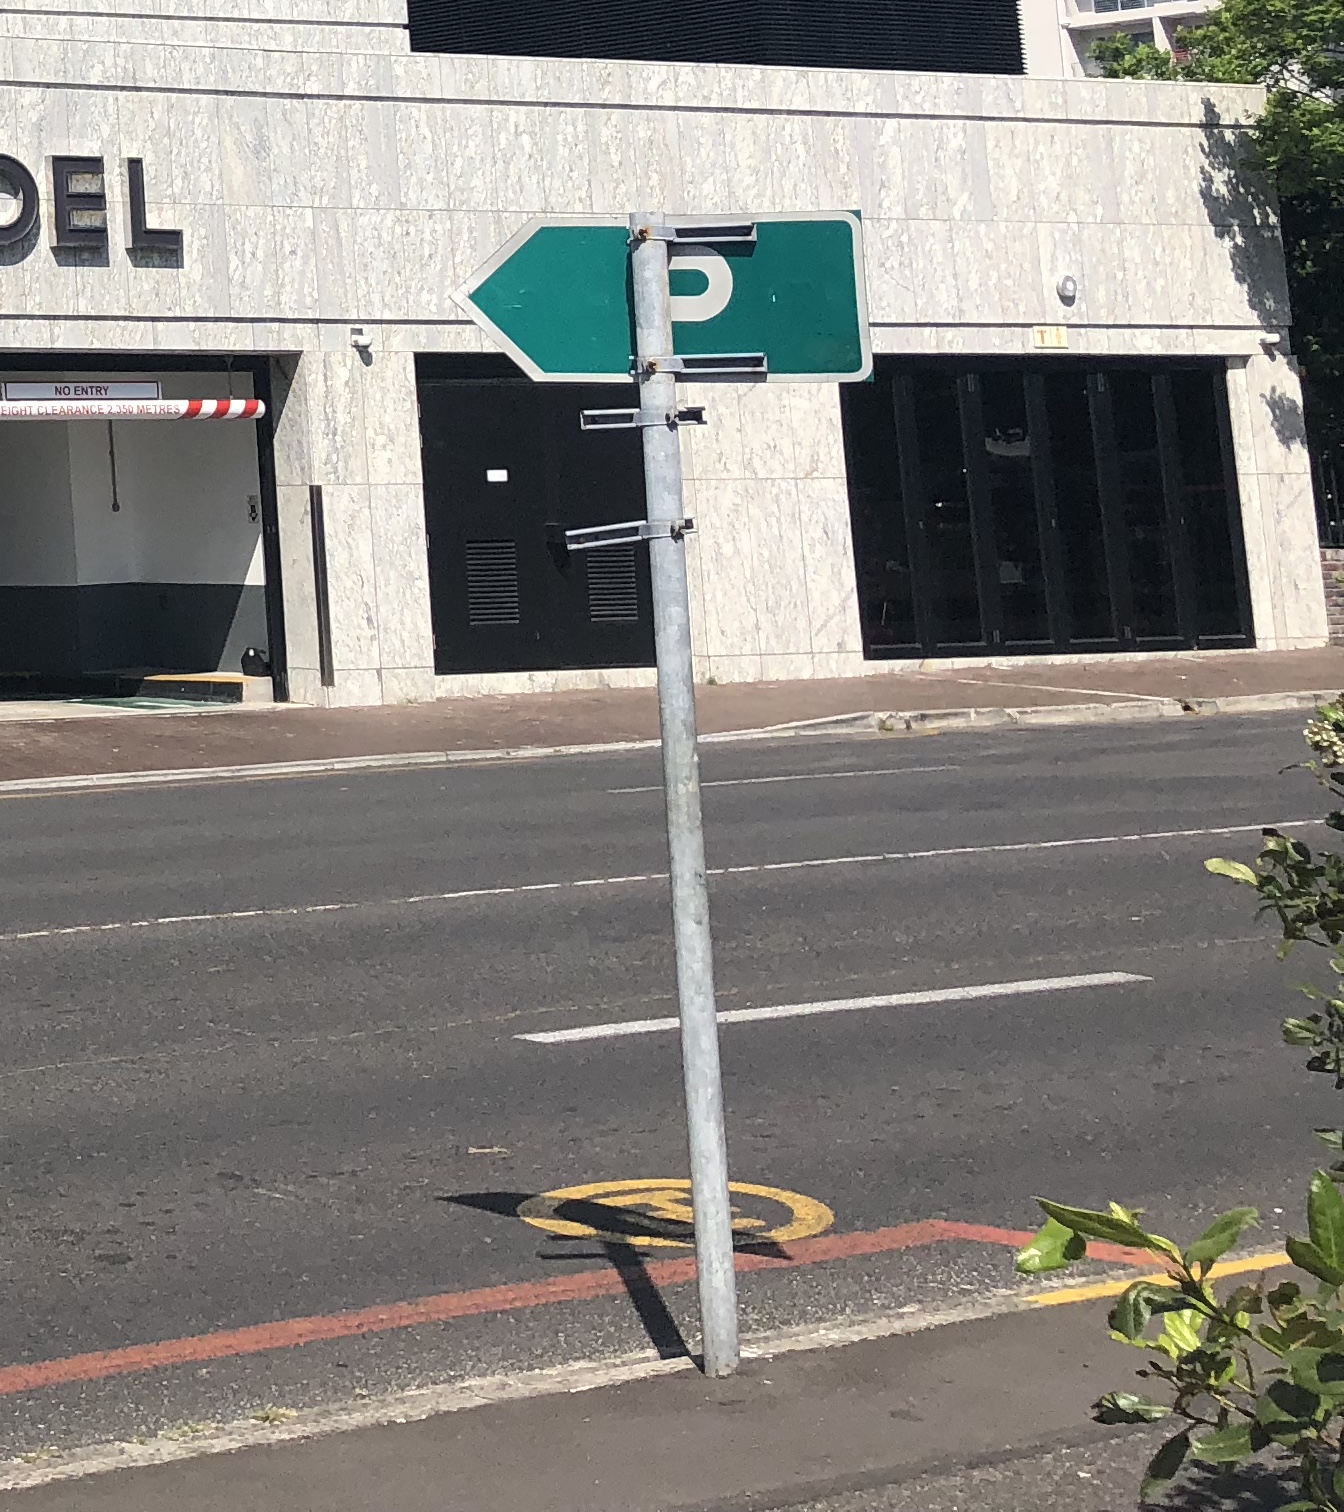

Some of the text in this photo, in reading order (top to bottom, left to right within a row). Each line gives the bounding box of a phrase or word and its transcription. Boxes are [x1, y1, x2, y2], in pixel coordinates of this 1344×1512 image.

[54, 385, 110, 396] NO ENTRY
[37, 404, 105, 416] CLEARANCE
[136, 404, 181, 415] METRES
